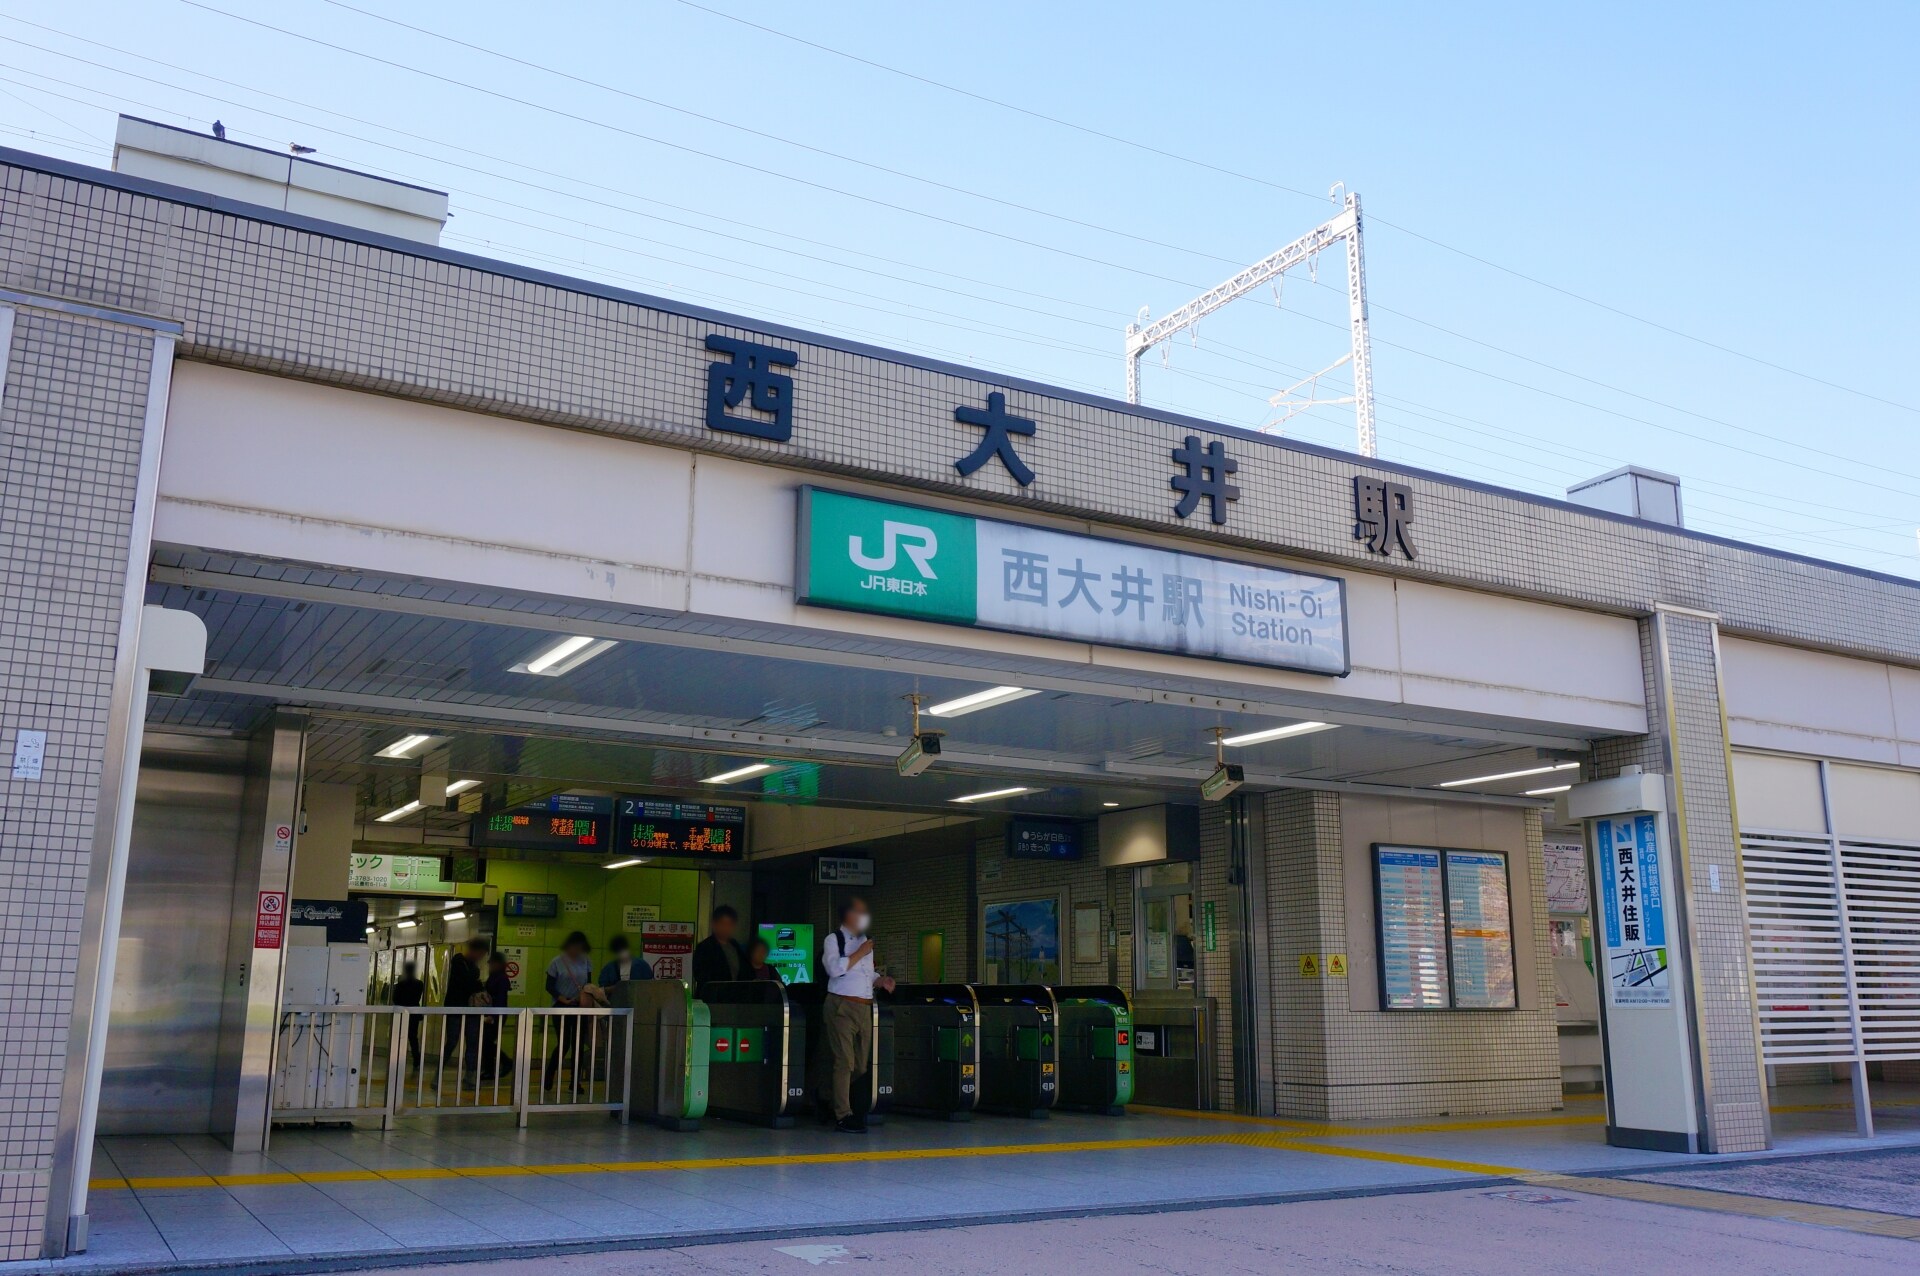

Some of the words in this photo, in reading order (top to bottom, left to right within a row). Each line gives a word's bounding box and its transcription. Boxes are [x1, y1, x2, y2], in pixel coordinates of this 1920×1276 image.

[706, 334, 1417, 560] 西大井駅
[849, 519, 938, 579] JR
[860, 574, 928, 598] JR東日本
[1001, 548, 1204, 628] 西大井駅
[1230, 582, 1323, 621] Nishi-Ōi
[1231, 610, 1314, 647] Station
[625, 800, 634, 814] 2
[489, 815, 513, 824] 14:18
[489, 823, 513, 832] 14:20
[633, 824, 655, 832] 14:12
[633, 831, 654, 840] 14:20
[1643, 820, 1661, 909] 不動産の相談窓口
[510, 896, 514, 907] 1
[1618, 848, 1640, 942] 西大井住販
[1112, 1006, 1127, 1016] IC
[1118, 1032, 1128, 1045] IC
